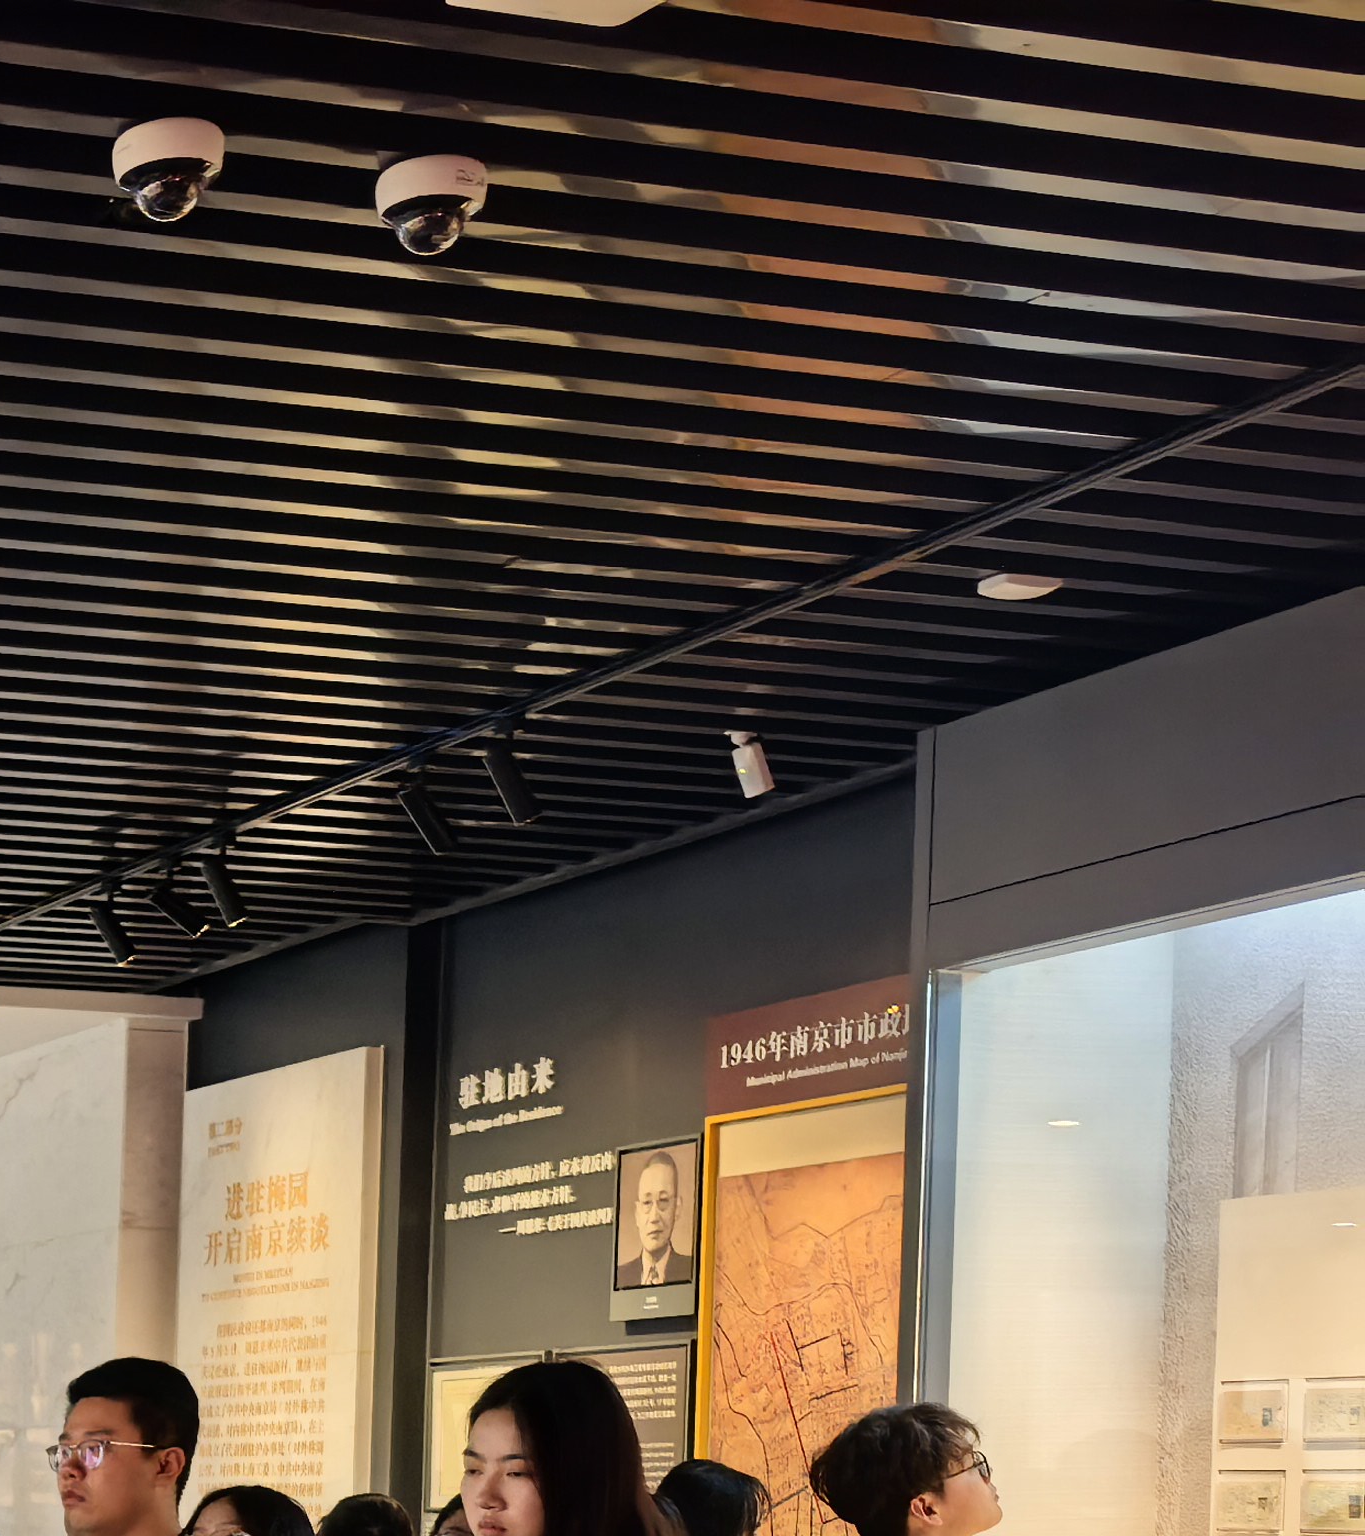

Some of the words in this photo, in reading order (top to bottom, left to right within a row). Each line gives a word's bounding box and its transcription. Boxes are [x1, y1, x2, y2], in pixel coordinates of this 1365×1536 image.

[458, 1055, 556, 1110] 驻地由来
[746, 1071, 786, 1088] Municipal
[786, 1061, 848, 1081] Administration
[849, 1057, 869, 1069] Map
[870, 1053, 880, 1065] of
[225, 1170, 310, 1221] 进驻梅园
[203, 1211, 331, 1268] 开启南京续谈
